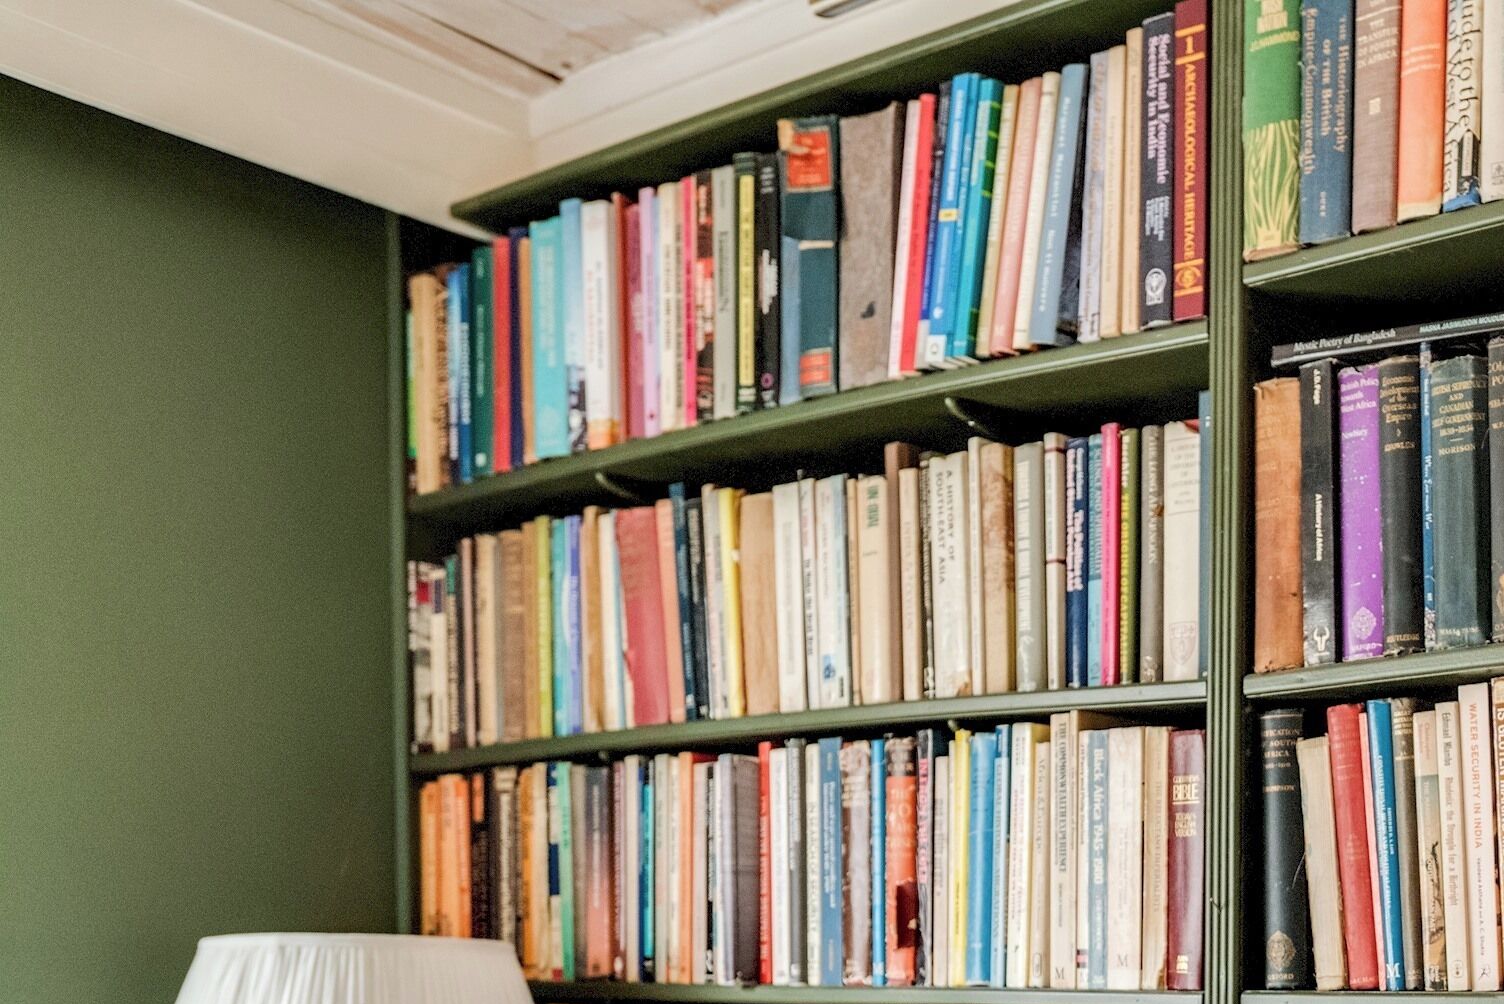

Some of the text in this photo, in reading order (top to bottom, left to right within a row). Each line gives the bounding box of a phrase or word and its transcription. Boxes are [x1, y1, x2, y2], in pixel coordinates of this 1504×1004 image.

[1344, 333, 1353, 344] of
[1354, 329, 1396, 346] Bangladesh
[1468, 703, 1479, 741] WATER
[1471, 745, 1480, 800] SECURITY
[1173, 784, 1199, 800] BIBLE
